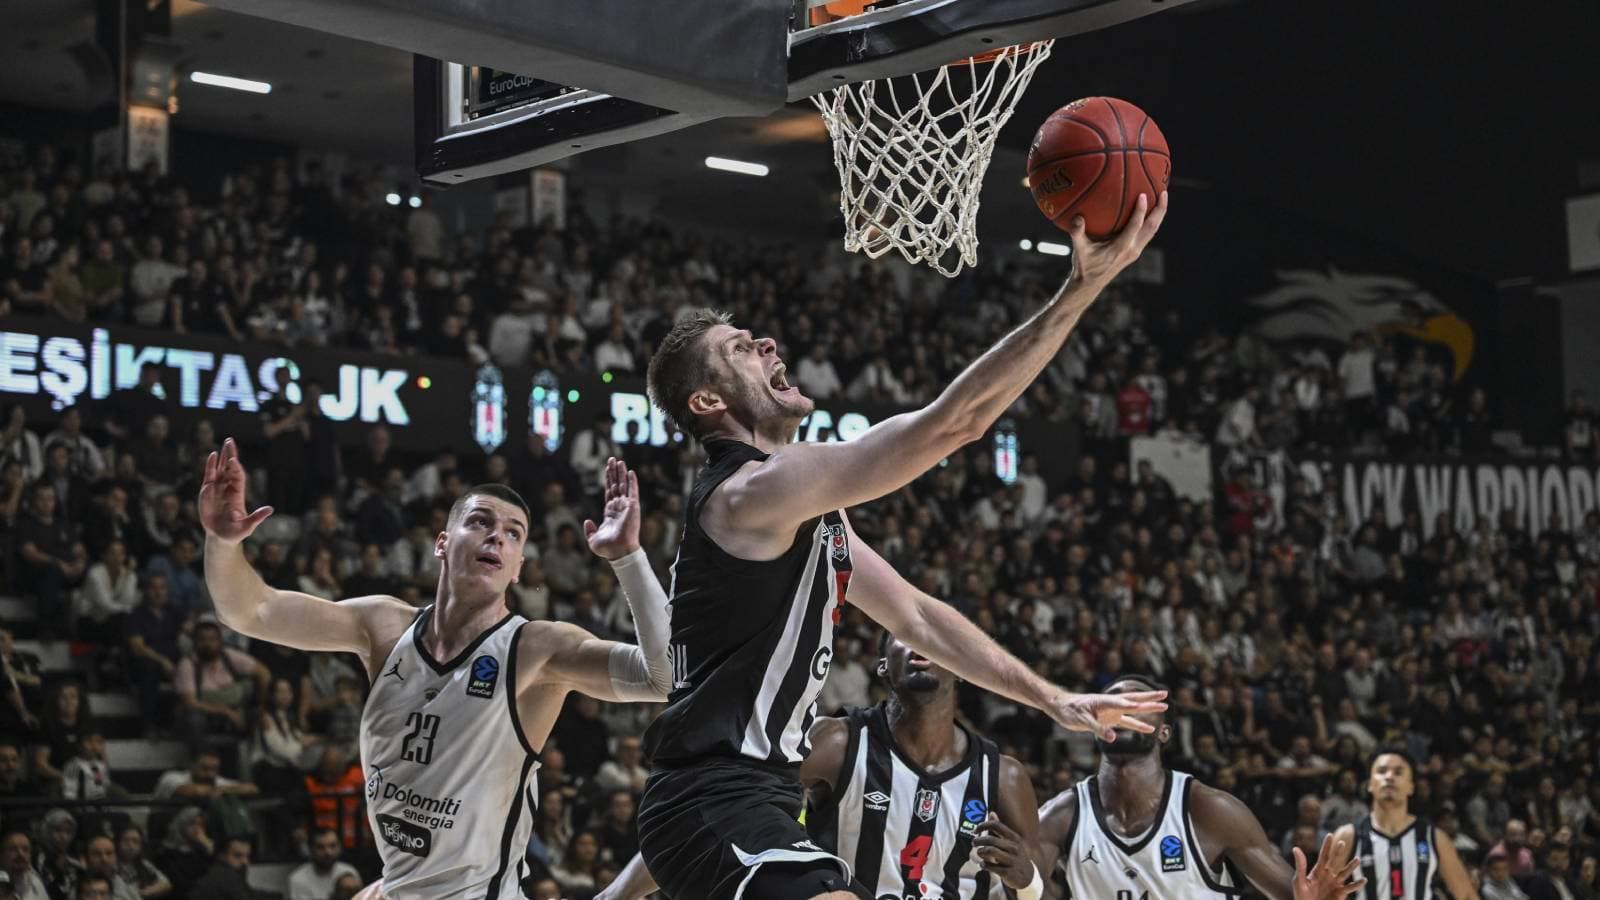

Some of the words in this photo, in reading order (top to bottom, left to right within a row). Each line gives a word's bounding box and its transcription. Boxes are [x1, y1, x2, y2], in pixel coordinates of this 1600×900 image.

[489, 73, 534, 95] EuroCup
[318, 363, 410, 426] JK
[1414, 462, 1600, 544] WARRIOR
[400, 711, 441, 766] 23
[383, 781, 463, 817] Dolomiti
[865, 802, 887, 812] umbro
[382, 821, 425, 849] TRENTINO
[402, 808, 455, 830] energia
[901, 834, 933, 881] 4
[1391, 869, 1403, 897] 1
